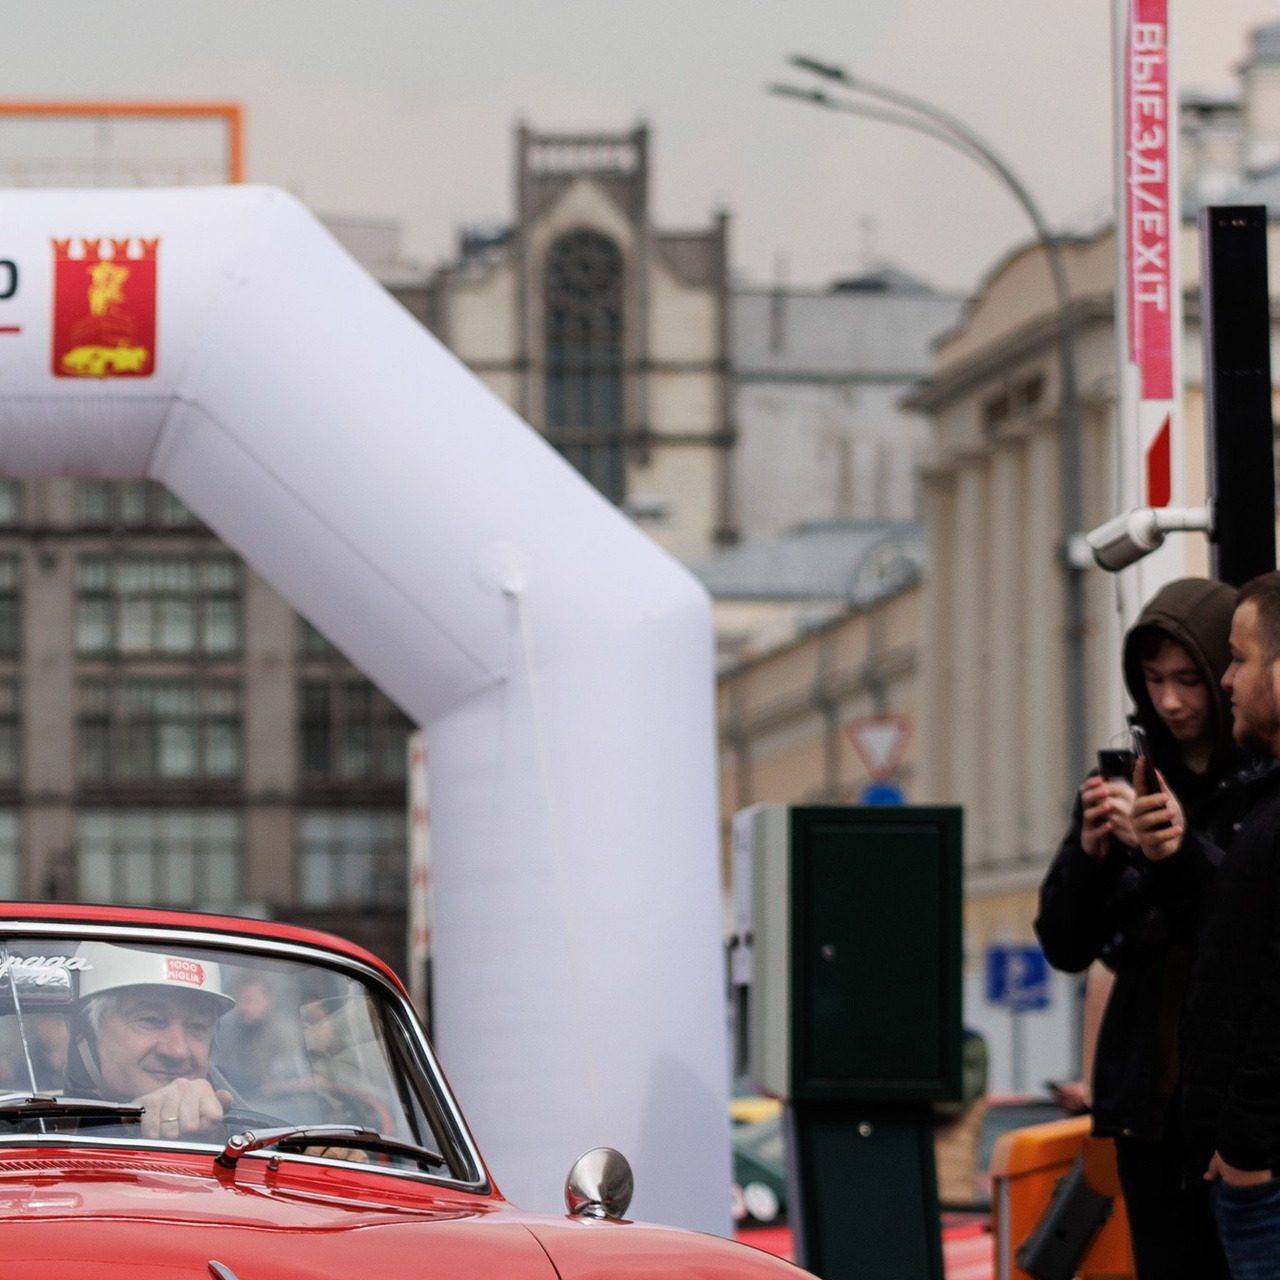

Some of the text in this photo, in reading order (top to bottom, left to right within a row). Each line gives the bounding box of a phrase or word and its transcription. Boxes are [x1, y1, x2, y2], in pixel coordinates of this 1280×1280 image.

[1129, 22, 1167, 312] ВЫЕЗД/EXIT
[168, 960, 198, 973] 1000
[167, 970, 200, 983] MIGLIA
